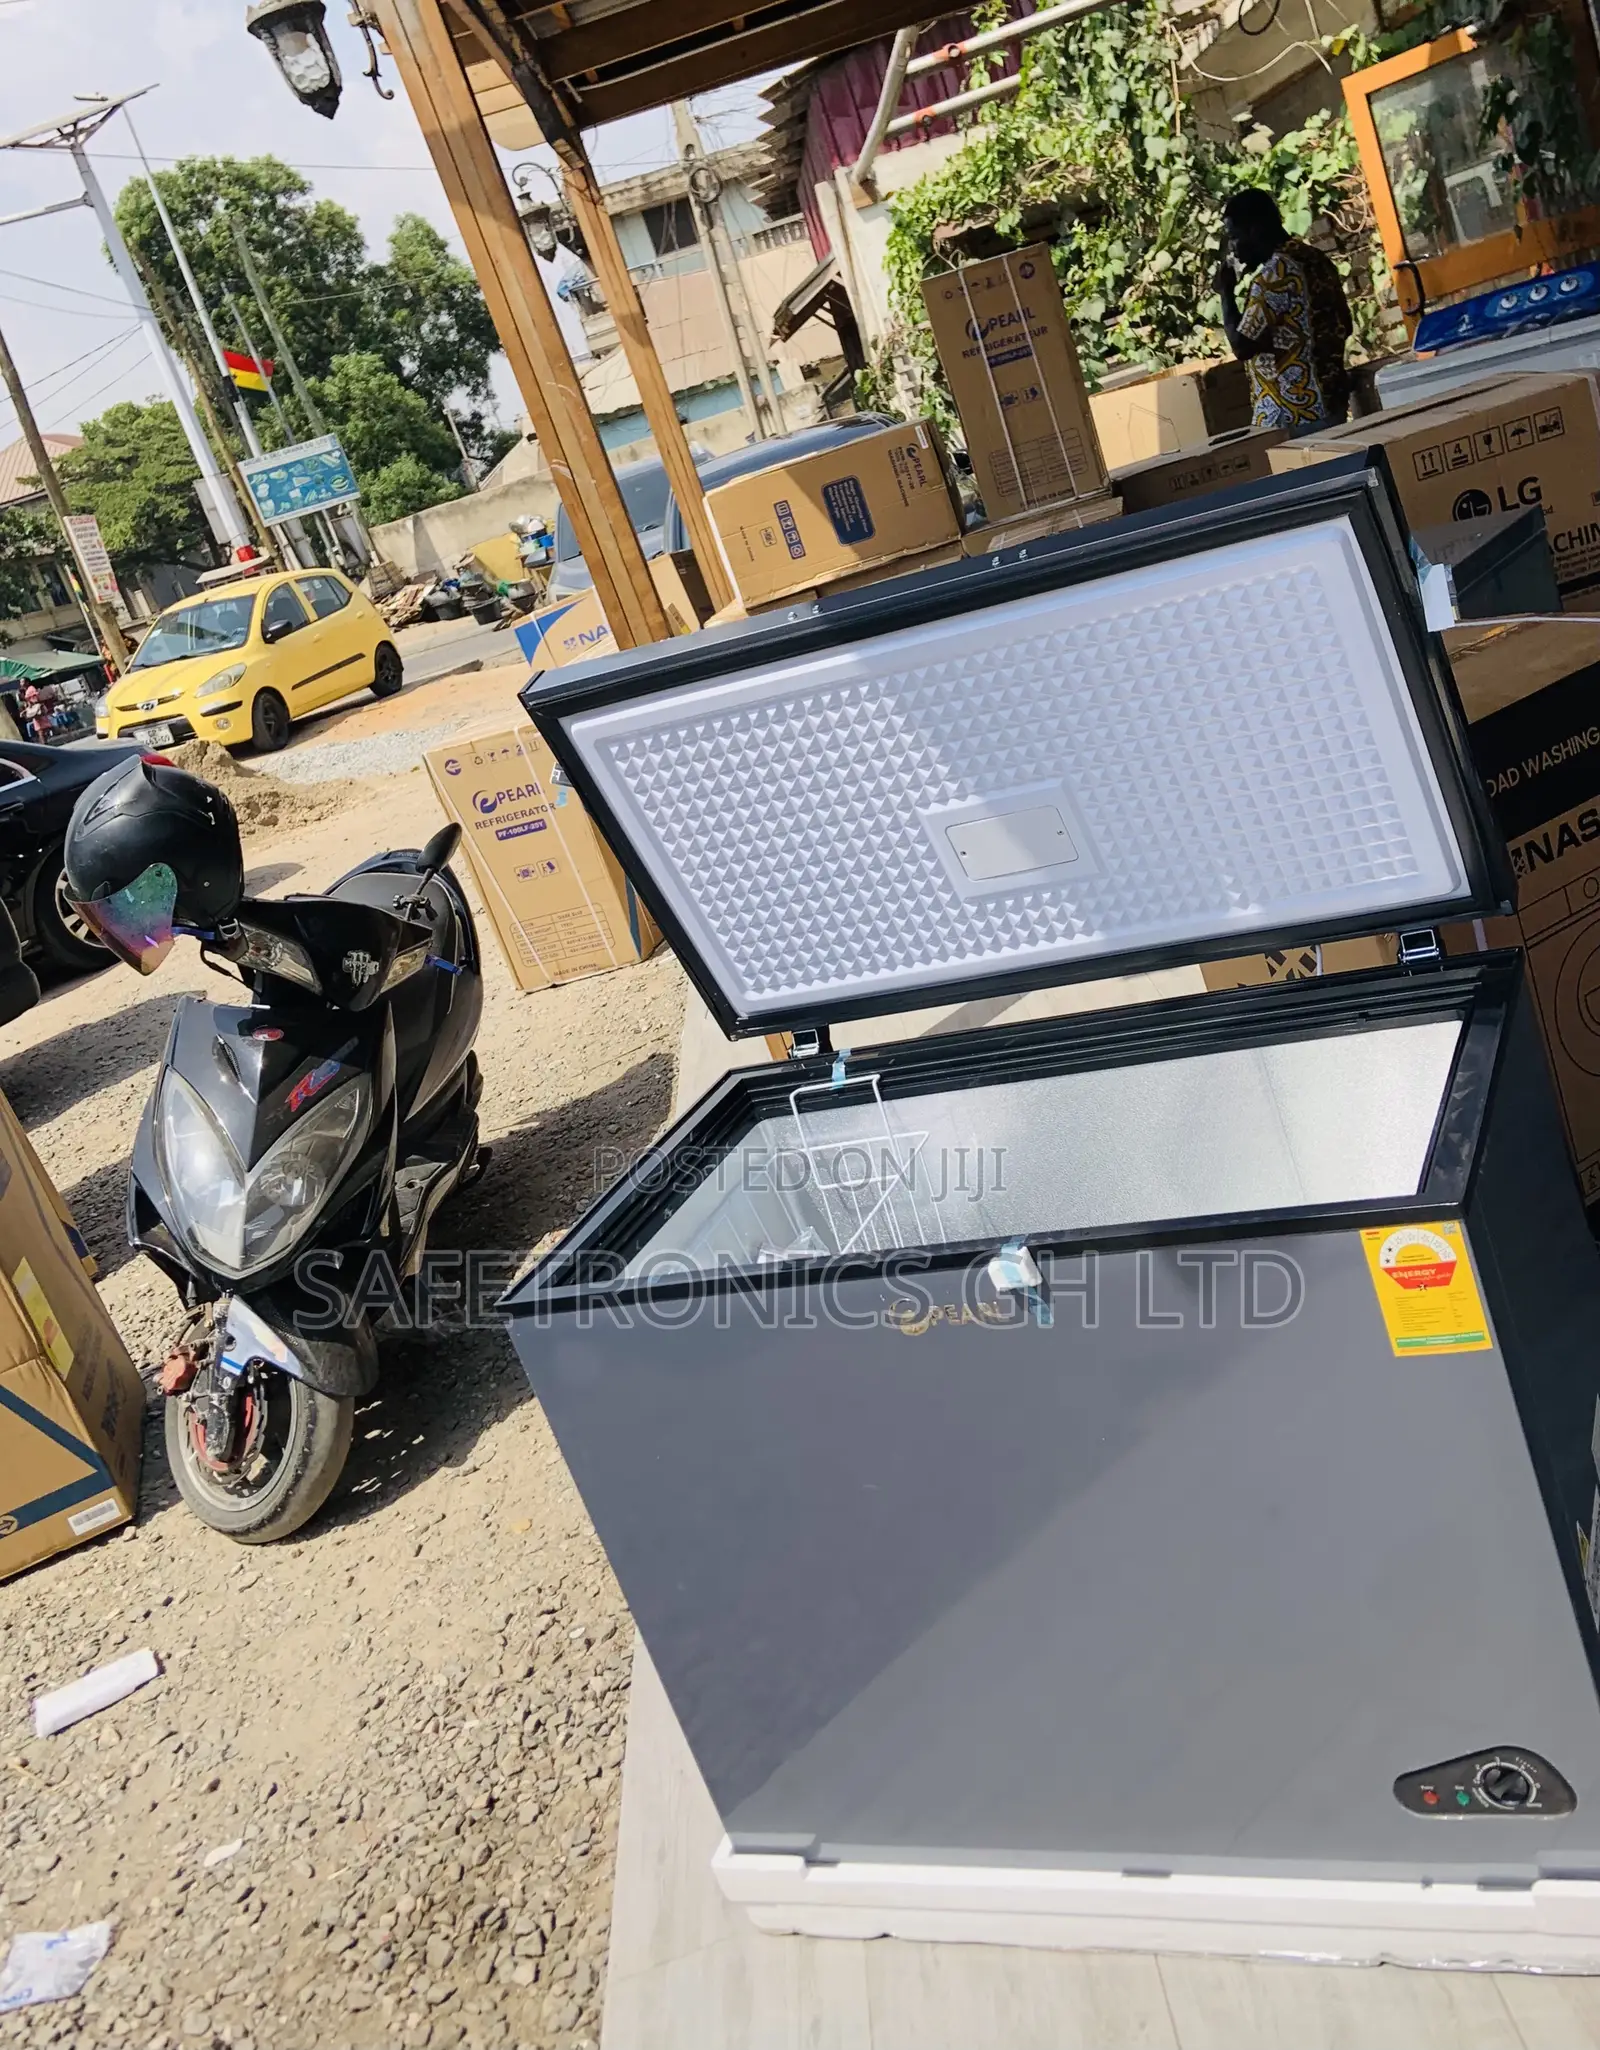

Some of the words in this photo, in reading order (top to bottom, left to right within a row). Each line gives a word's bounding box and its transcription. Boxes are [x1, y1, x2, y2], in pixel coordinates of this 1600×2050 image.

[912, 457, 927, 487] PEARL
[1497, 477, 1542, 512] LG
[1521, 727, 1600, 778] WASHING
[474, 802, 557, 830] REFRIGERATOR
